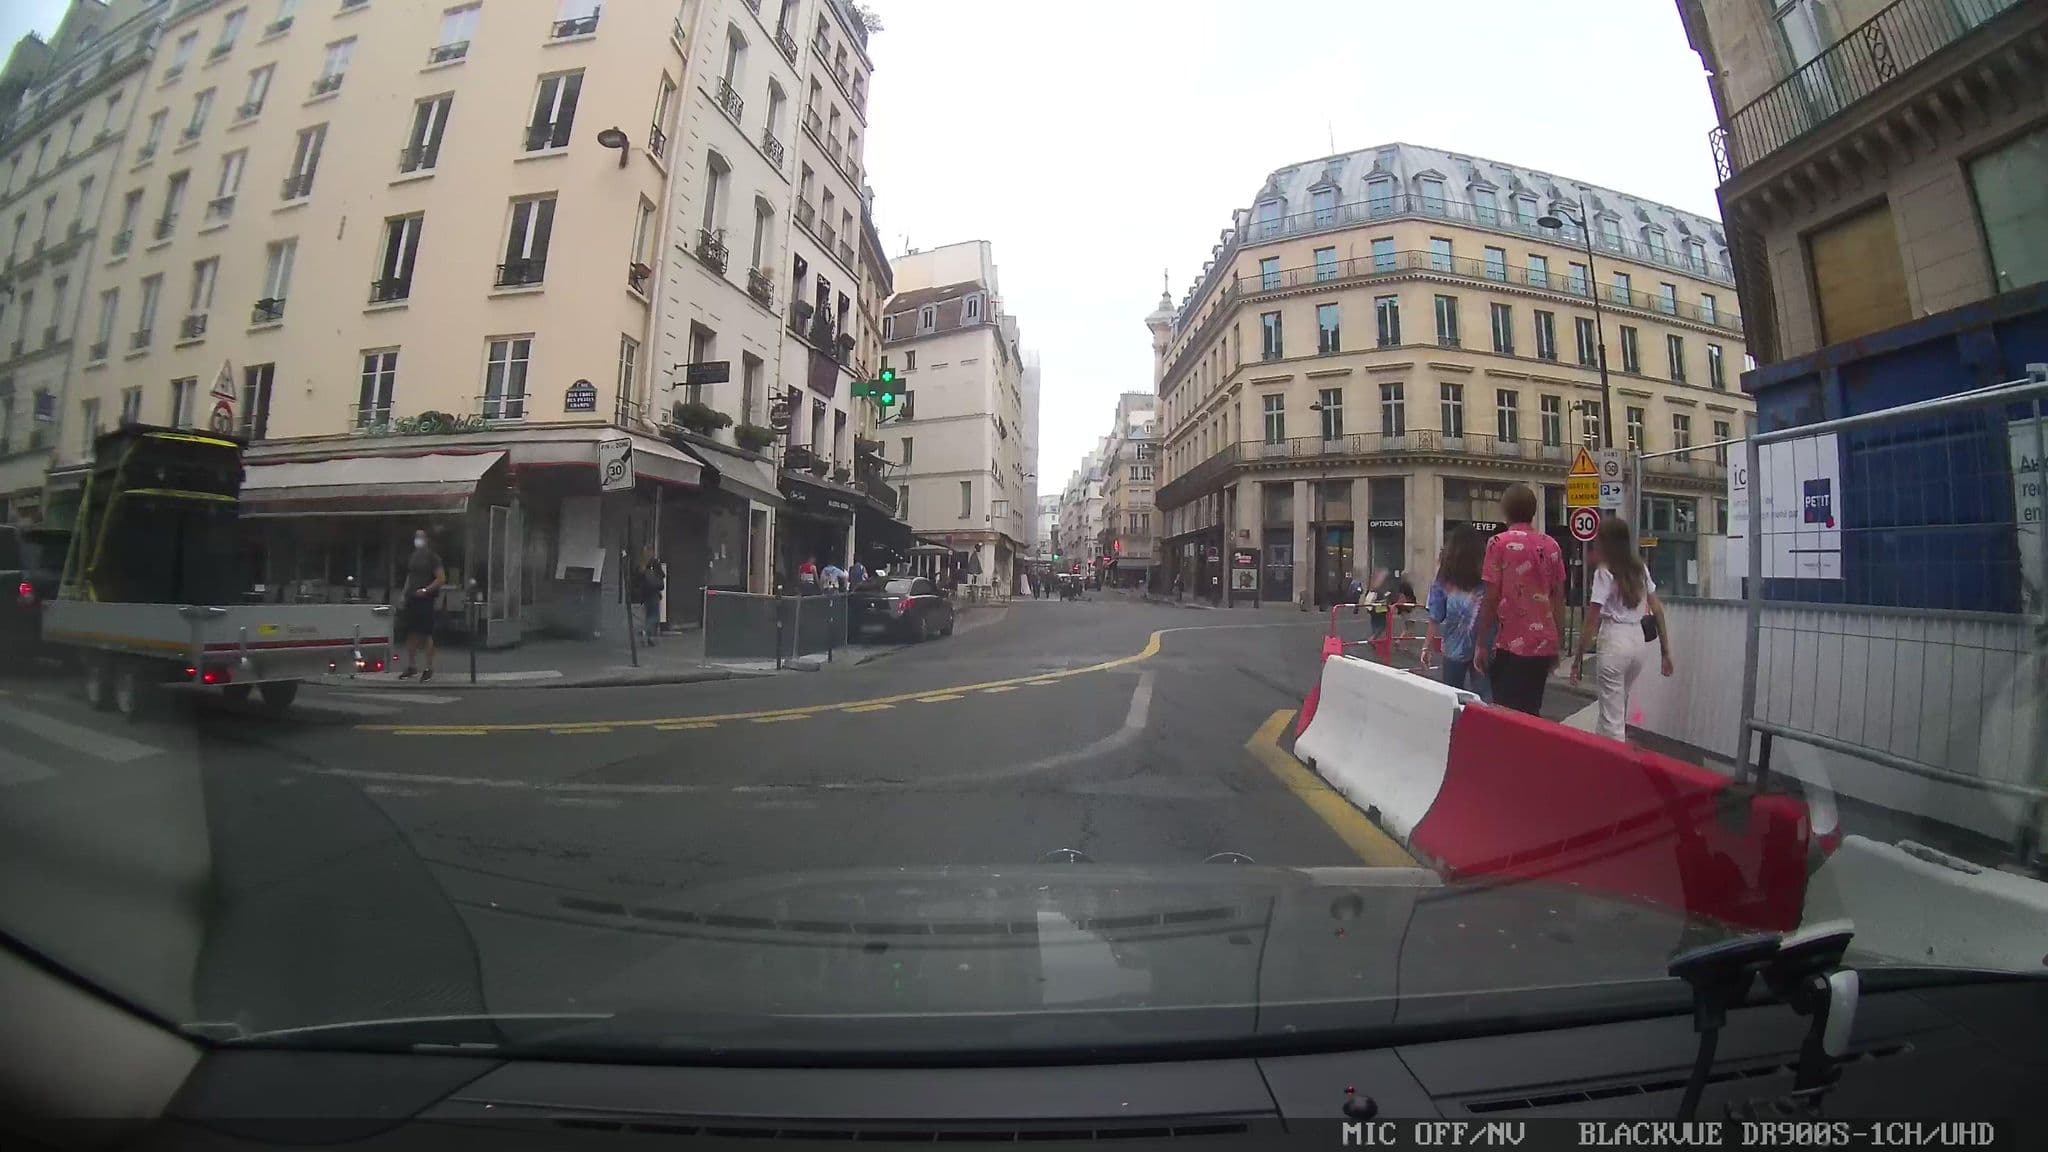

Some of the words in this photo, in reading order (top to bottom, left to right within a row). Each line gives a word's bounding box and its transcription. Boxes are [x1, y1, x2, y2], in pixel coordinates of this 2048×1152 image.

[610, 465, 622, 476] 30
[1805, 495, 1831, 508] PETIT
[1370, 520, 1403, 528] OPTICIENS
[1577, 517, 1594, 531] 30
